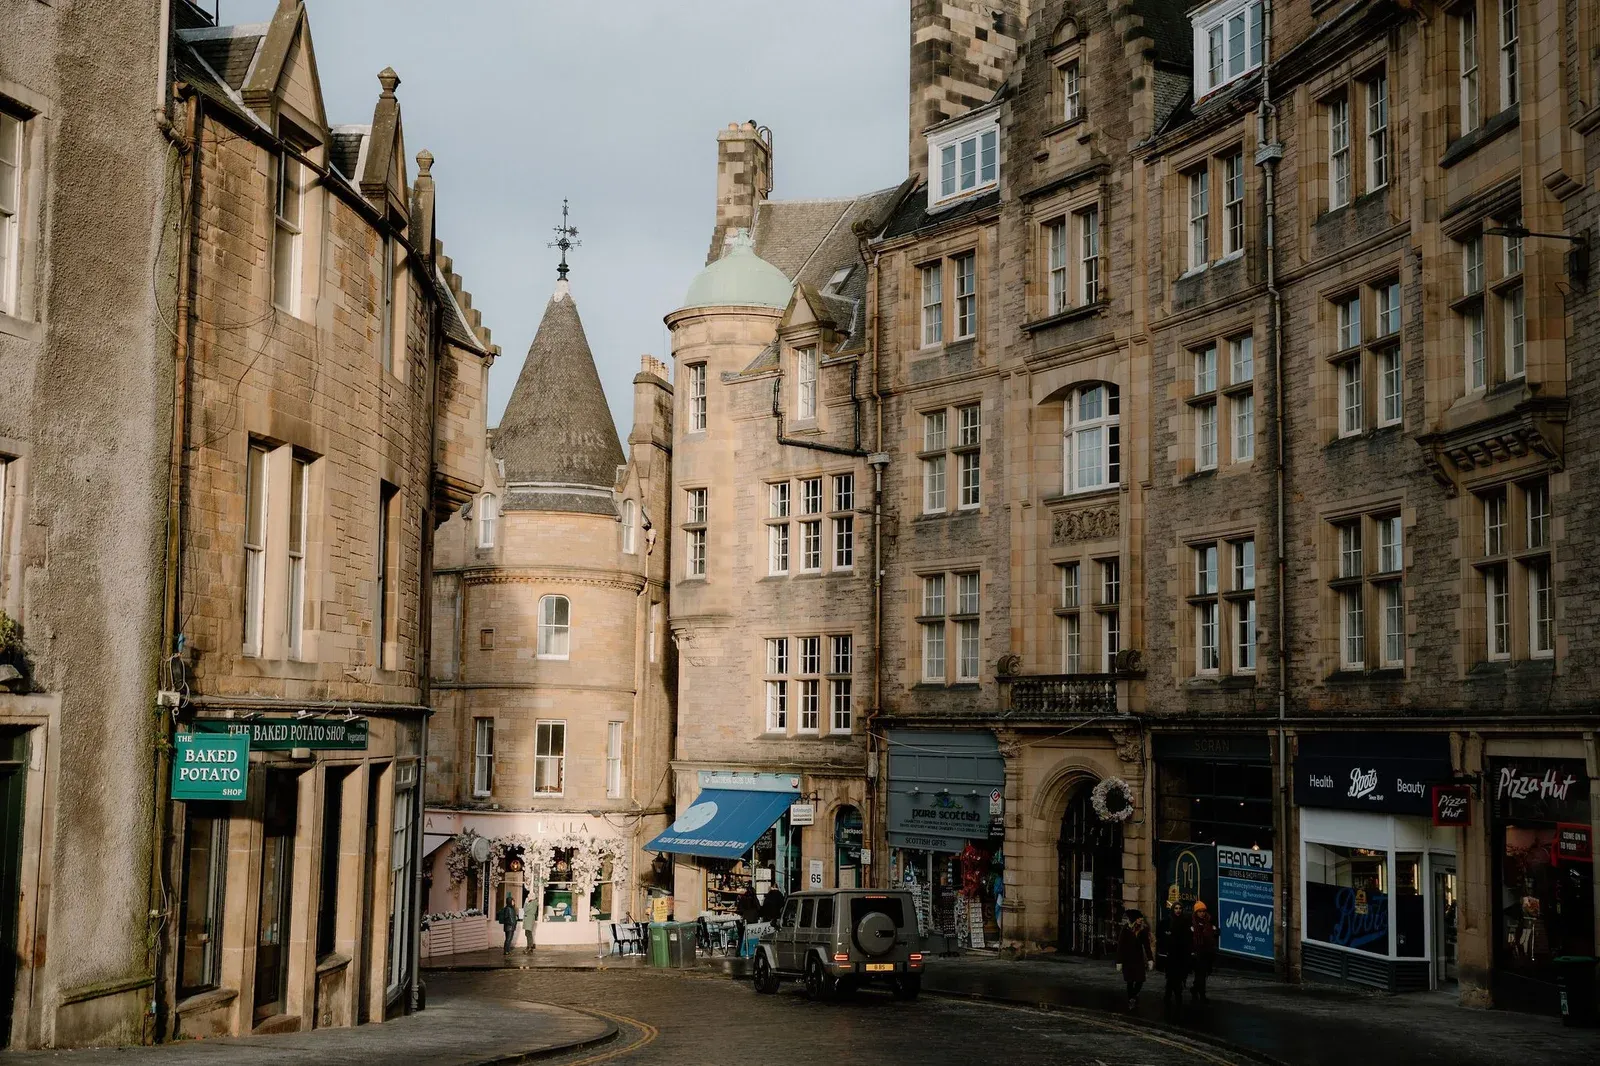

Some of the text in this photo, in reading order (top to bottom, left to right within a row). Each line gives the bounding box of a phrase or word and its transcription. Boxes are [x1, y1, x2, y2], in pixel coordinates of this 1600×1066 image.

[177, 735, 192, 743] THE
[253, 724, 288, 741] BAKED
[290, 725, 325, 741] POTATO
[325, 725, 346, 741] SHOP
[1194, 739, 1230, 752] SCRAN
[185, 749, 238, 764] BAKED
[179, 767, 241, 782] POTATO
[1309, 774, 1334, 789] Health
[1347, 767, 1378, 799] Boots
[1396, 778, 1426, 798] Beauty
[1498, 767, 1577, 801] Pizza Hut
[222, 788, 243, 797] SHOP
[1438, 794, 1468, 808] Pizza
[939, 809, 980, 822] scottish
[1441, 806, 1463, 819] Hut
[700, 838, 727, 848] CROSS
[905, 836, 947, 848] SCOTTISH GIFTS
[1219, 850, 1267, 870] FRANCEY
[811, 873, 822, 884] 65
